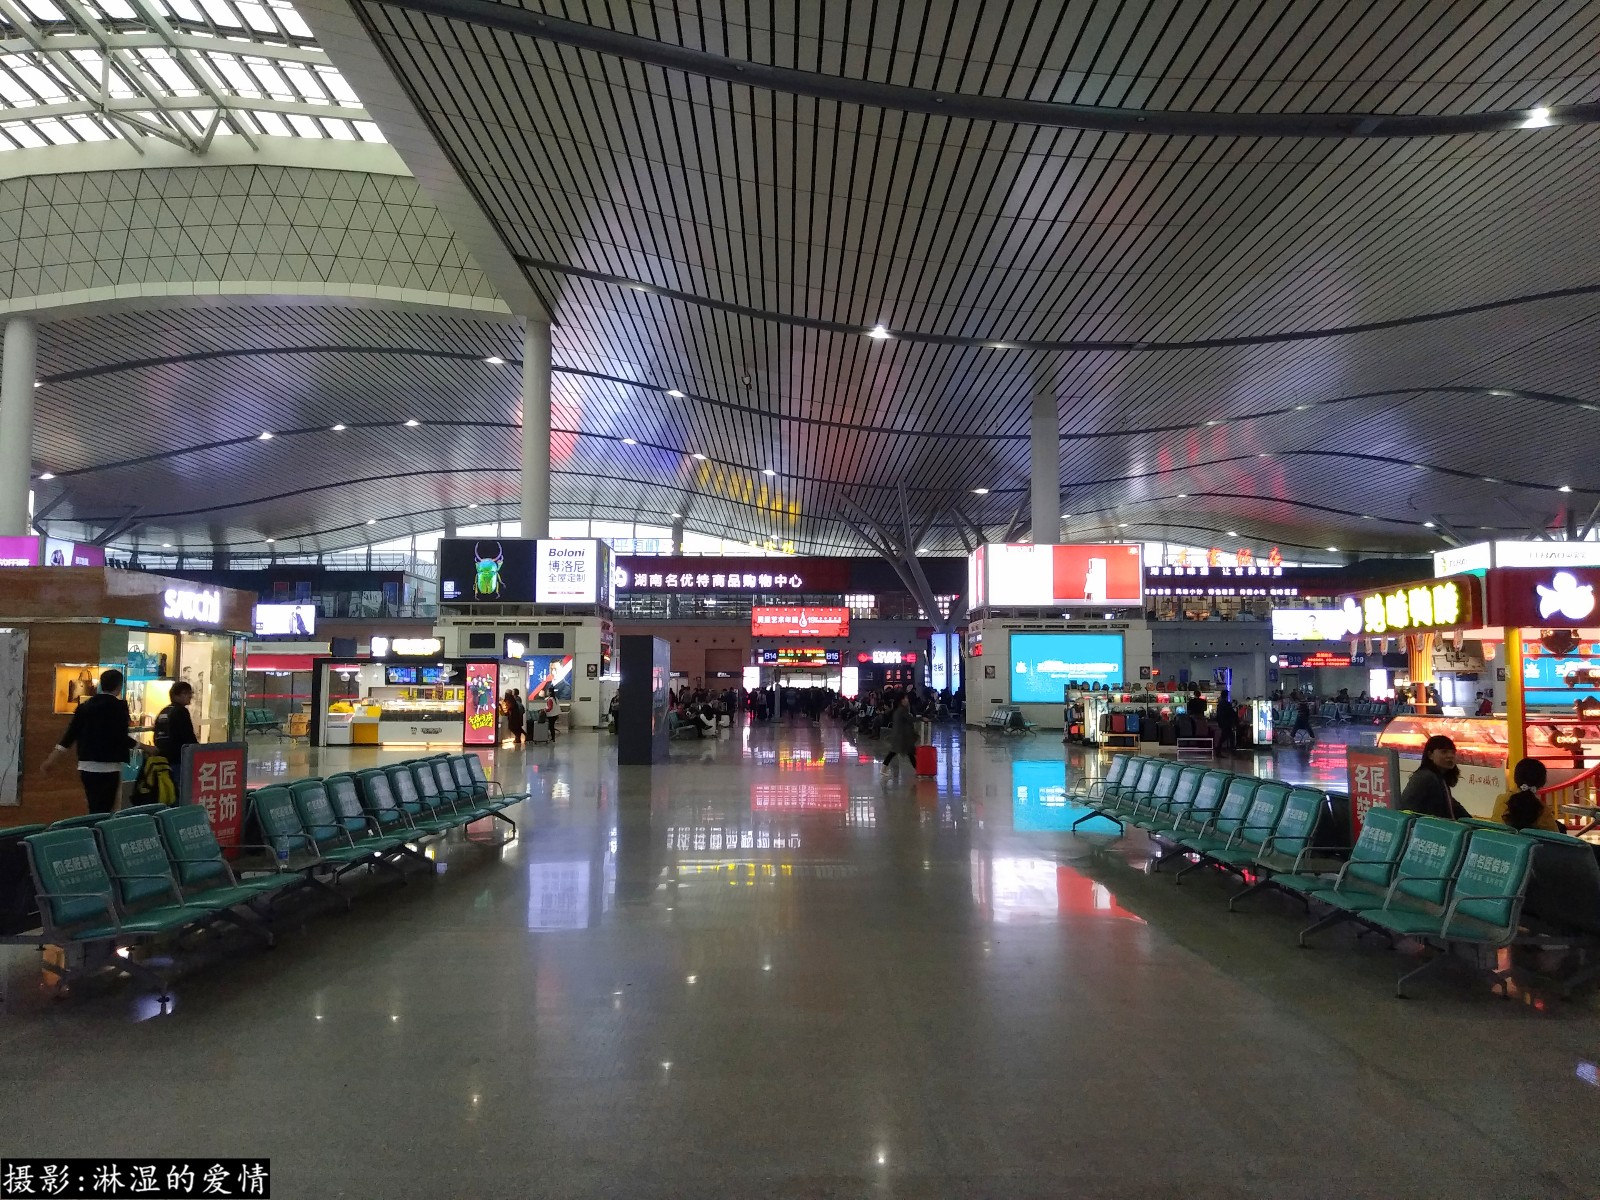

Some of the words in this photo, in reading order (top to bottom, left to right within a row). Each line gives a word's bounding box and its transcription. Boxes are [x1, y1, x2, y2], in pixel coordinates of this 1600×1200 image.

[548, 548, 586, 557] Boloni
[548, 560, 585, 572] 博洛尼
[548, 573, 585, 583] 全屋定制
[634, 573, 803, 588] 湖南名优特商品购物中心
[764, 652, 777, 660] B14
[826, 652, 839, 660] B15
[198, 760, 237, 792] 名匠
[1355, 764, 1386, 797] 名匠
[198, 793, 237, 824] 装饰
